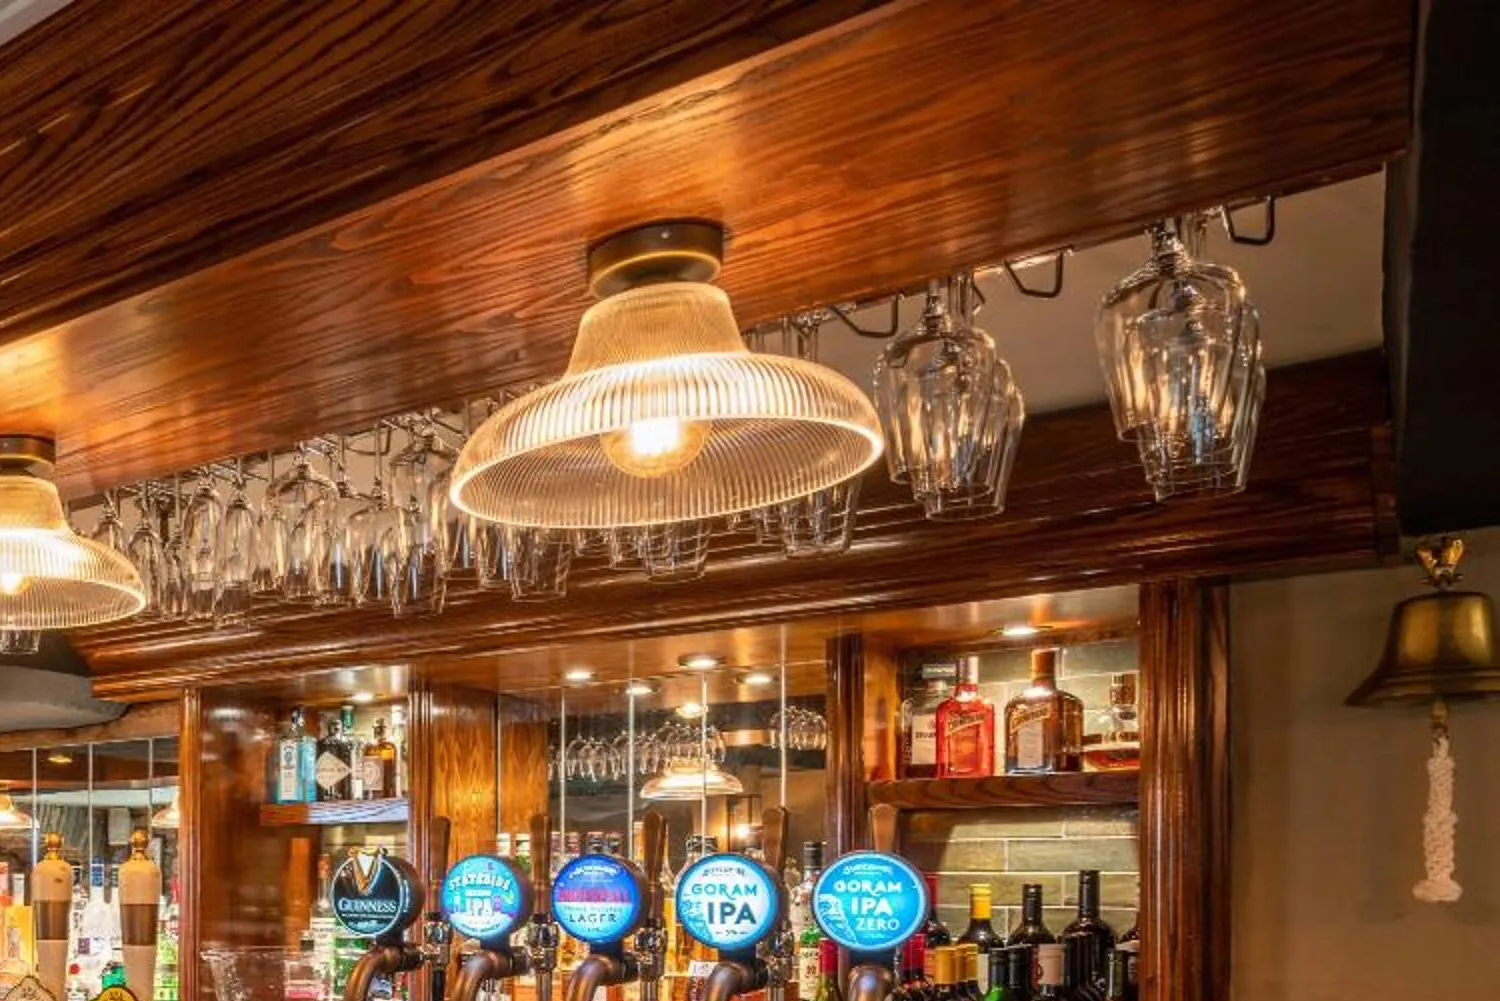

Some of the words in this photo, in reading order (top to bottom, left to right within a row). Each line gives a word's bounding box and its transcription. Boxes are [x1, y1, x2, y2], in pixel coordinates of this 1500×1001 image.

[691, 883, 758, 900] GORAM
[833, 880, 902, 897] GORAM
[338, 897, 398, 913] GUINNESS
[467, 898, 494, 916] IPA
[707, 902, 757, 924] IPA
[851, 897, 893, 915] IPA
[569, 913, 617, 923] LAGER
[856, 918, 900, 931] ZERO
